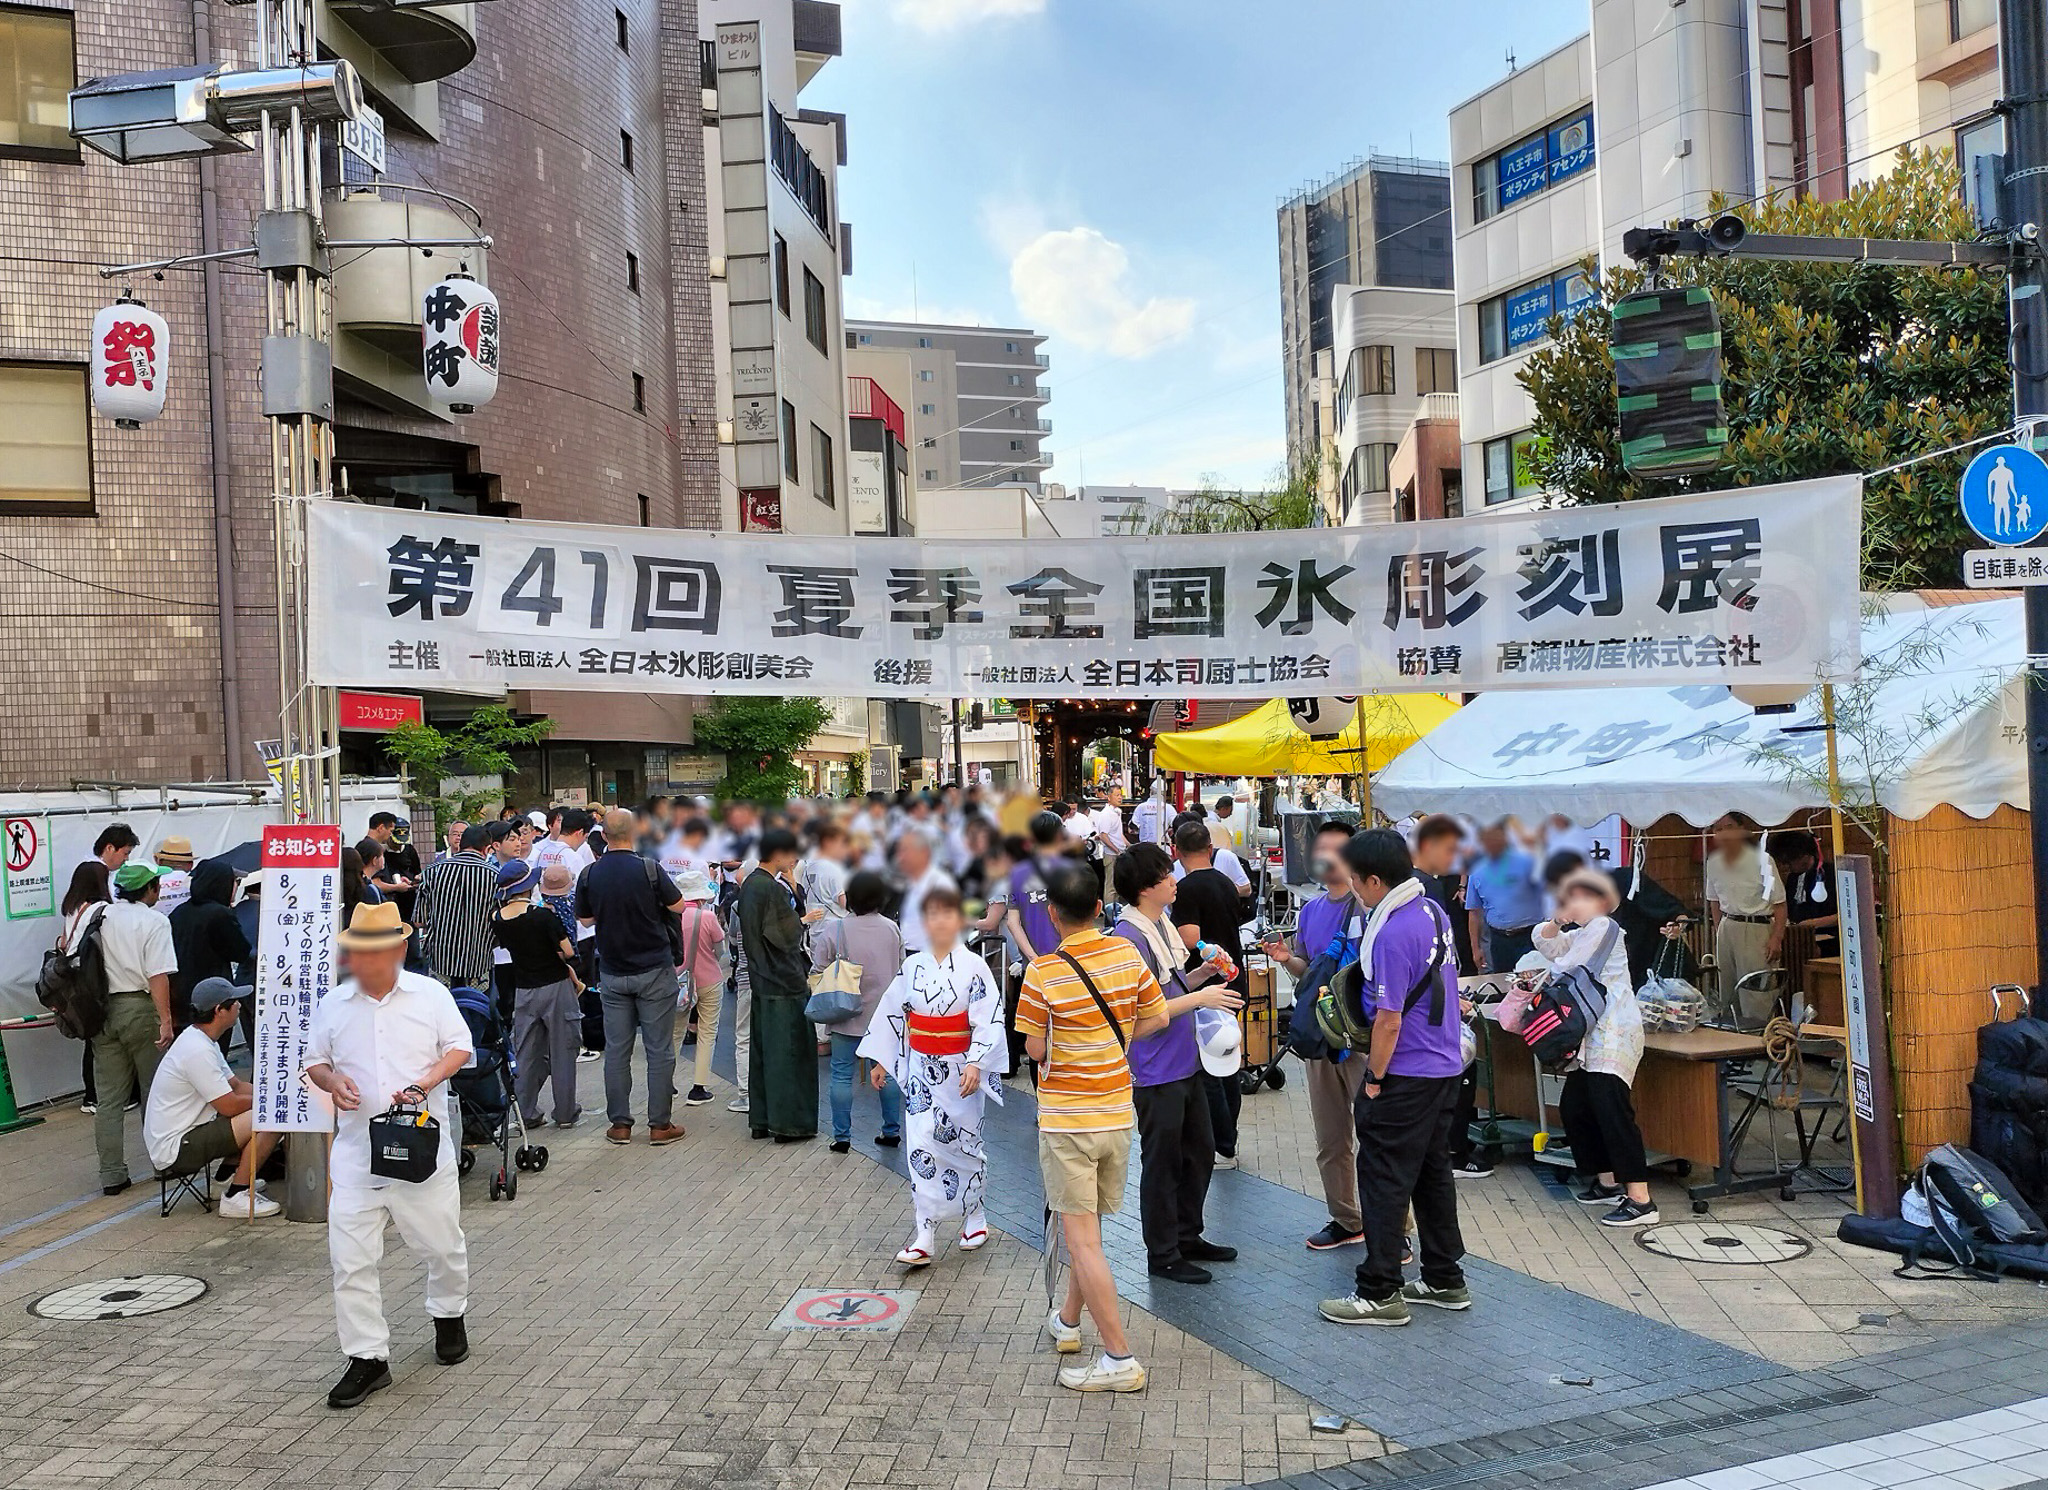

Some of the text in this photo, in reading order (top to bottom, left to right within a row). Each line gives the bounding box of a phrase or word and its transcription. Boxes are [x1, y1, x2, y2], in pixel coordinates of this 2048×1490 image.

[720, 31, 757, 45] ひまわり
[728, 49, 750, 60] ビル
[1507, 148, 1543, 177] 八王子市
[1512, 294, 1548, 318] 八王子市
[425, 285, 467, 388] 中町
[103, 320, 156, 391] 祭
[134, 350, 149, 377] 八王子
[388, 640, 441, 671] 主催
[873, 657, 933, 686] 後援
[1397, 644, 1462, 677] 協賛
[268, 838, 335, 857] お知らせ
